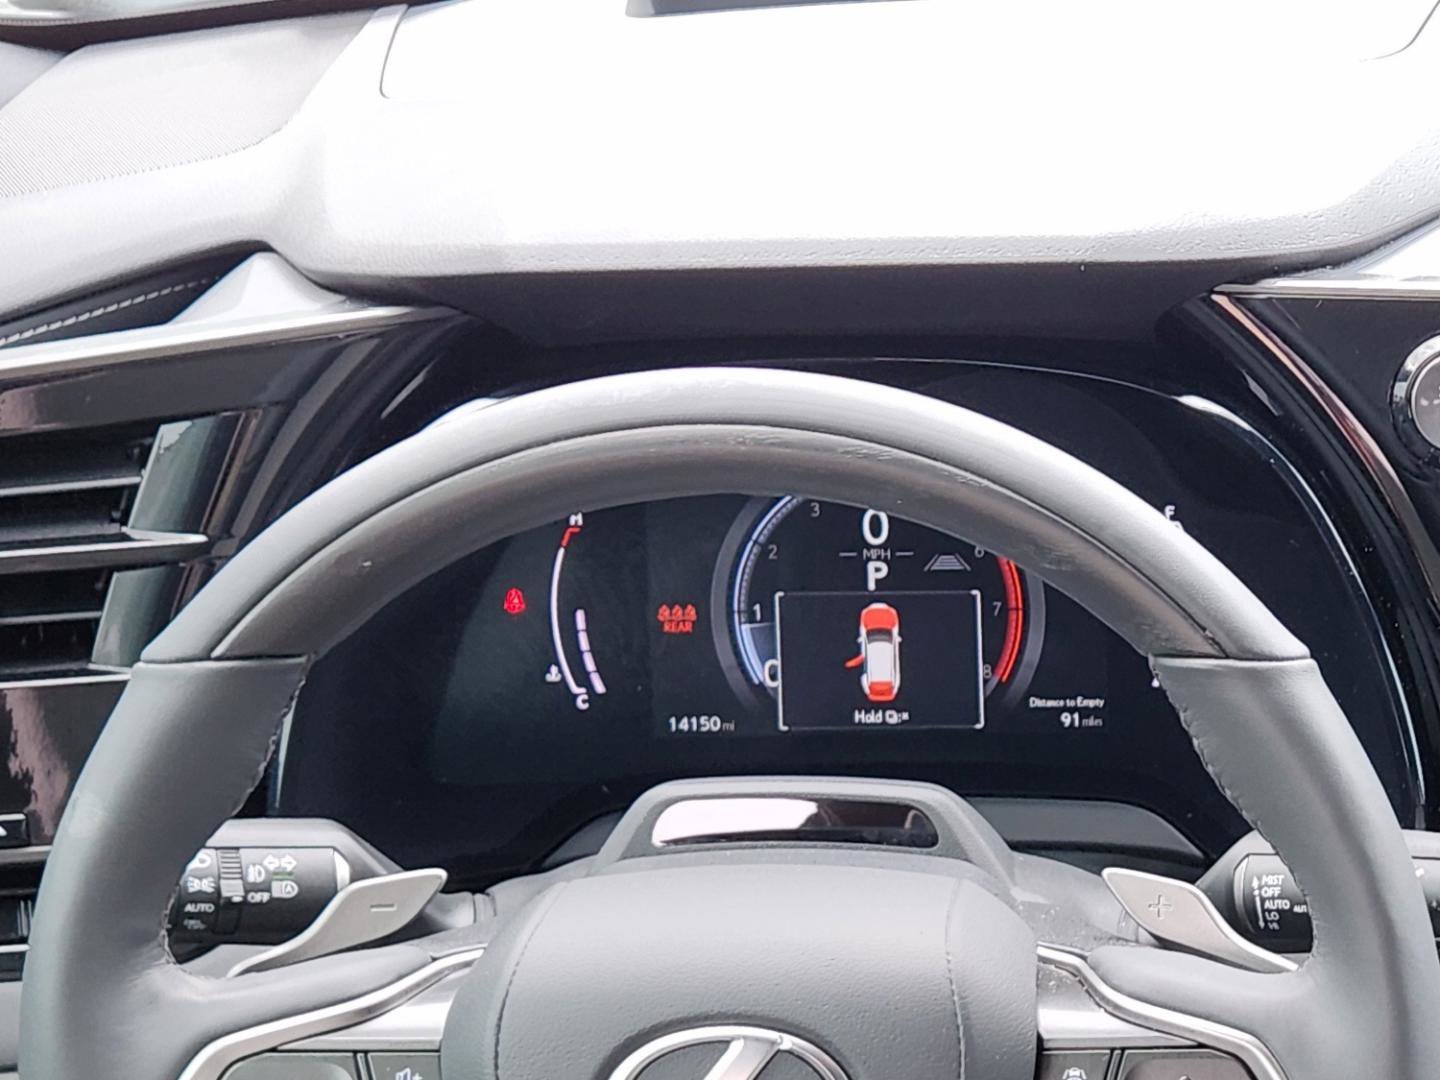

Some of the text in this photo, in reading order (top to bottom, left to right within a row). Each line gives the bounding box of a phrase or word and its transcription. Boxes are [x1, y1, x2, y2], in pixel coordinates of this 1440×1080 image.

[810, 502, 821, 517] 3
[862, 509, 889, 545] 0
[768, 545, 778, 559] 2
[862, 549, 891, 559] MPH
[866, 561, 889, 591] P
[752, 603, 762, 622] 1
[992, 601, 1002, 616] 7
[663, 621, 693, 633] REAR
[983, 664, 992, 679] 8
[575, 694, 590, 710] C
[1029, 697, 1105, 709] Distance to Empty
[854, 709, 883, 724] Hold
[1060, 712, 1103, 728] 91 miles
[668, 716, 736, 732] 14150 mi
[1260, 874, 1285, 886] MIST
[246, 891, 271, 903] OFF
[1260, 886, 1281, 898] OFF
[183, 902, 215, 913] AUTO
[1264, 899, 1291, 910] AUTO
[1293, 904, 1308, 913] AUT
[1264, 911, 1280, 920] LO
